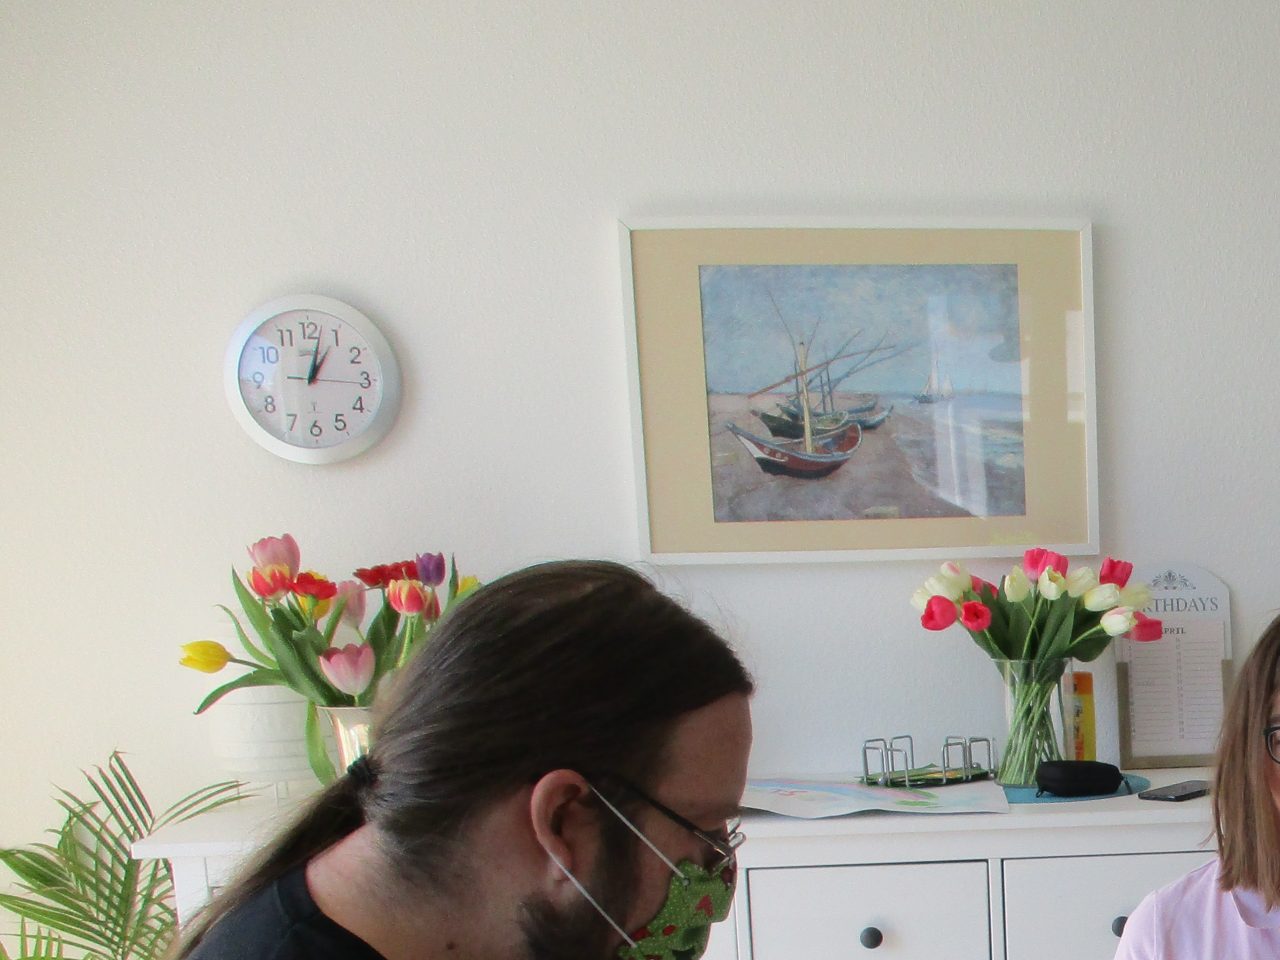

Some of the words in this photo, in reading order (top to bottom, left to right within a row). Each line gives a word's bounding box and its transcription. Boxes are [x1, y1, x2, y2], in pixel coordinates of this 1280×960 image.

[277, 329, 293, 347] 11
[299, 322, 319, 340] 12
[332, 329, 339, 347] 1
[258, 346, 279, 364] 10
[350, 347, 362, 364] 2
[252, 371, 265, 389] 9
[359, 371, 372, 389] 3
[264, 396, 276, 413] 8
[352, 396, 365, 413] 4
[286, 414, 298, 431] 7
[309, 420, 323, 437] 6
[334, 414, 347, 431] 5
[1142, 597, 1219, 613] THDAYS
[1161, 627, 1186, 635] PRIL
